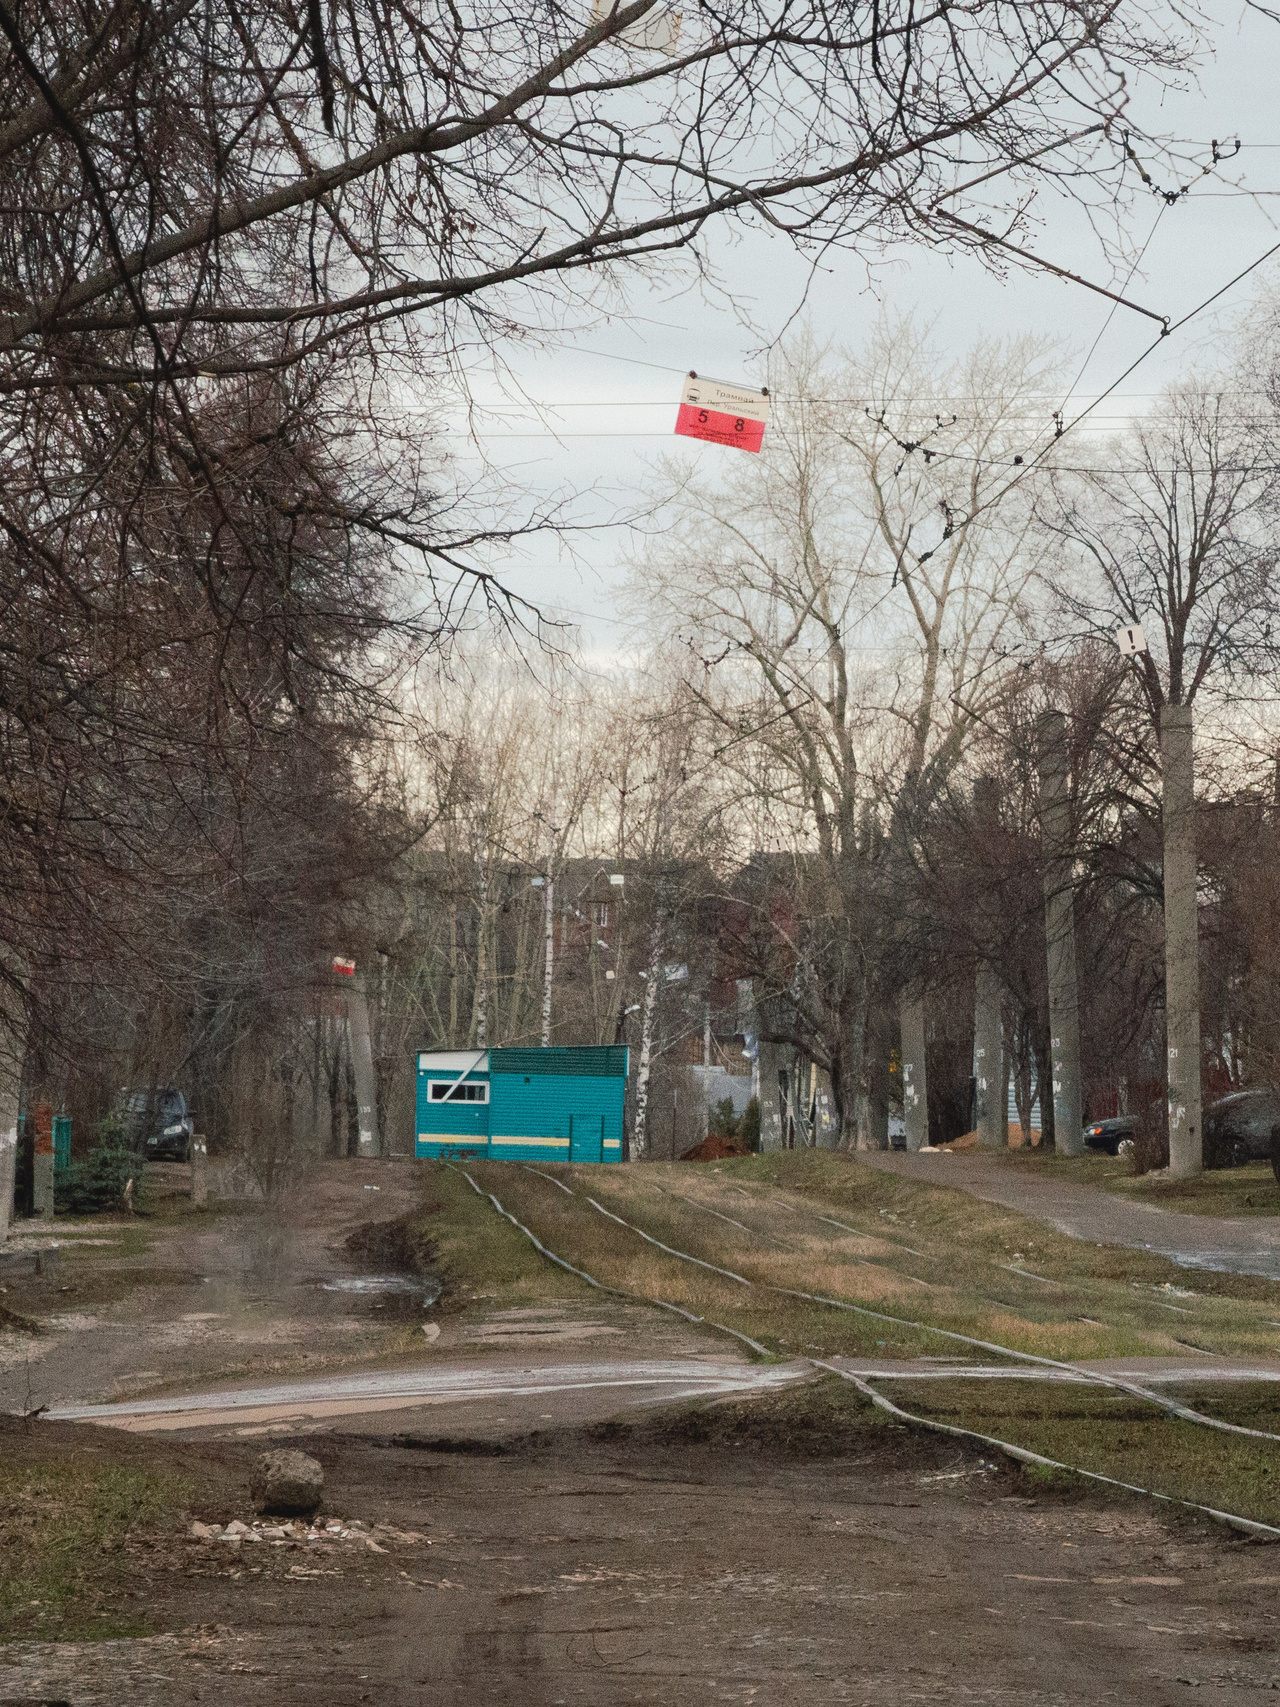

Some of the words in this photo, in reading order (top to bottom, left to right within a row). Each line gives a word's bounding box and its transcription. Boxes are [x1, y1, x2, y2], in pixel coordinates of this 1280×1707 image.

[716, 389, 754, 403] Трамвай
[698, 410, 709, 423] 5
[734, 418, 745, 432] 8
